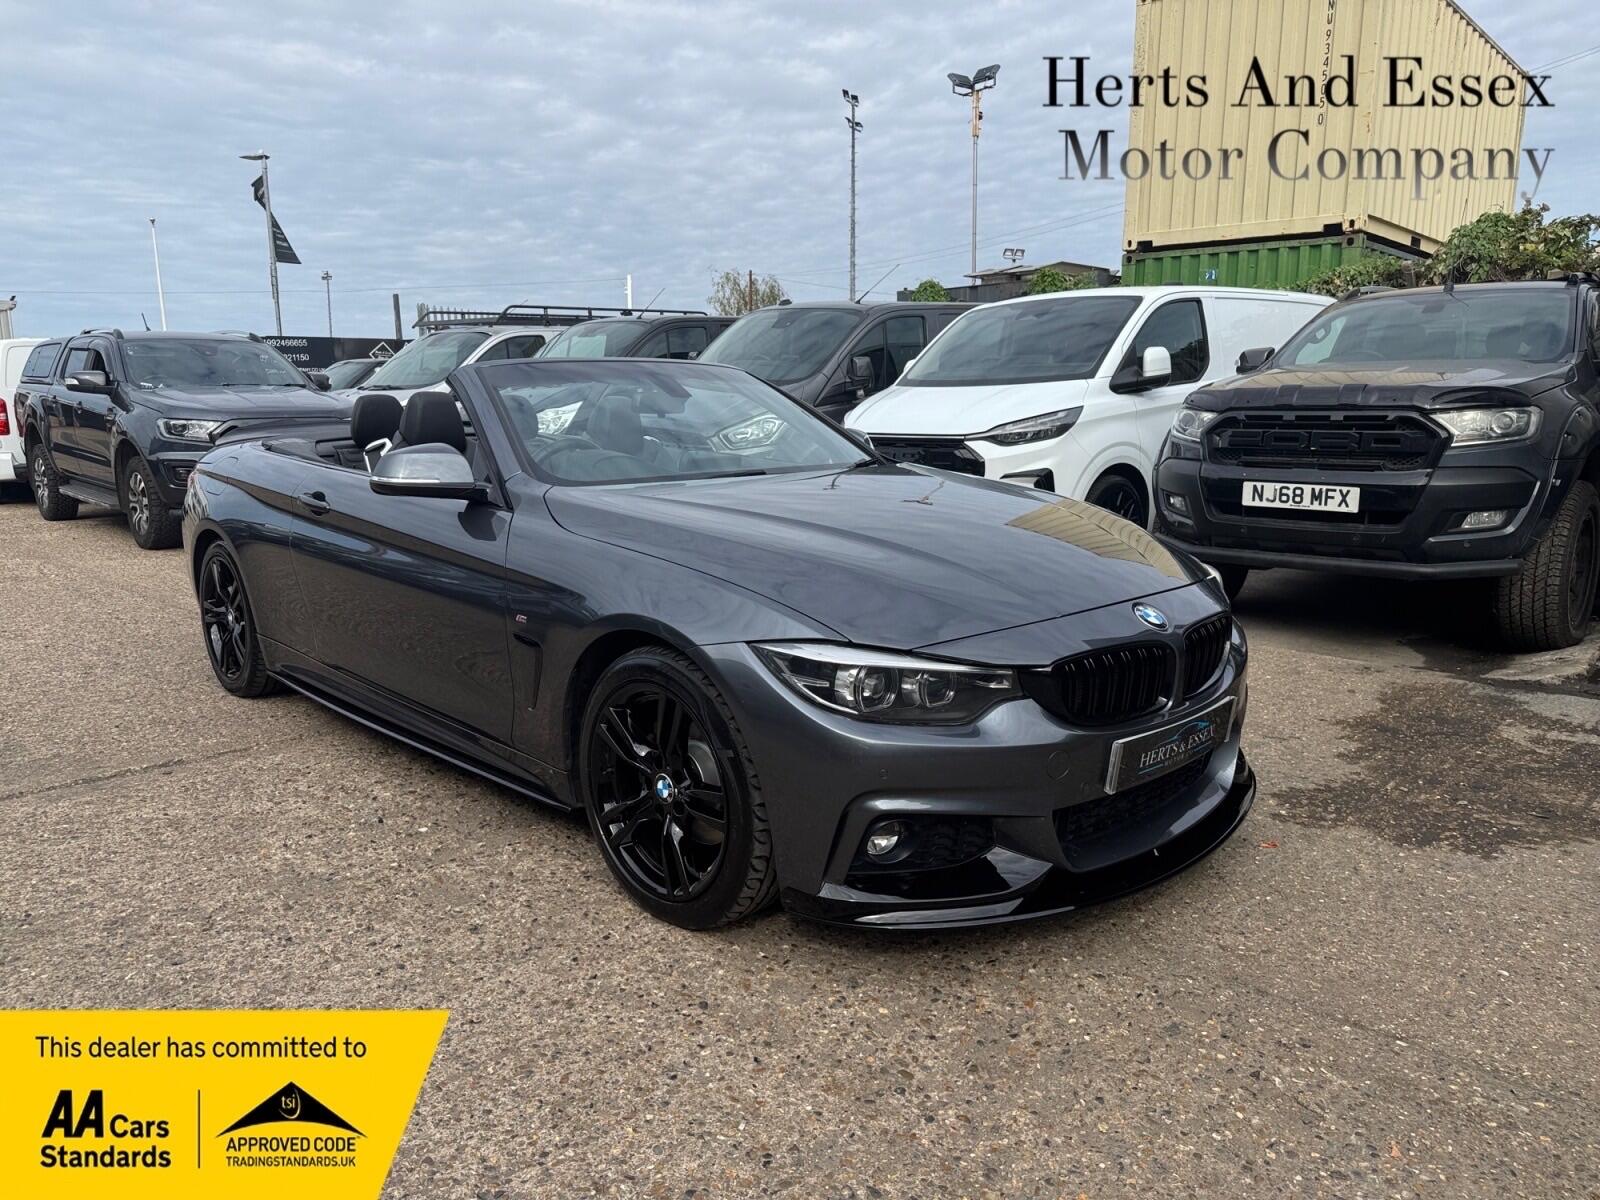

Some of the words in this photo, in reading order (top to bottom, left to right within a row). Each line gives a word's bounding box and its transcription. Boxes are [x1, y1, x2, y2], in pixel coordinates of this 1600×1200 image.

[1251, 484, 1304, 504] NJ68
[1310, 487, 1351, 508] MFX
[1139, 741, 1179, 768] HERTS
